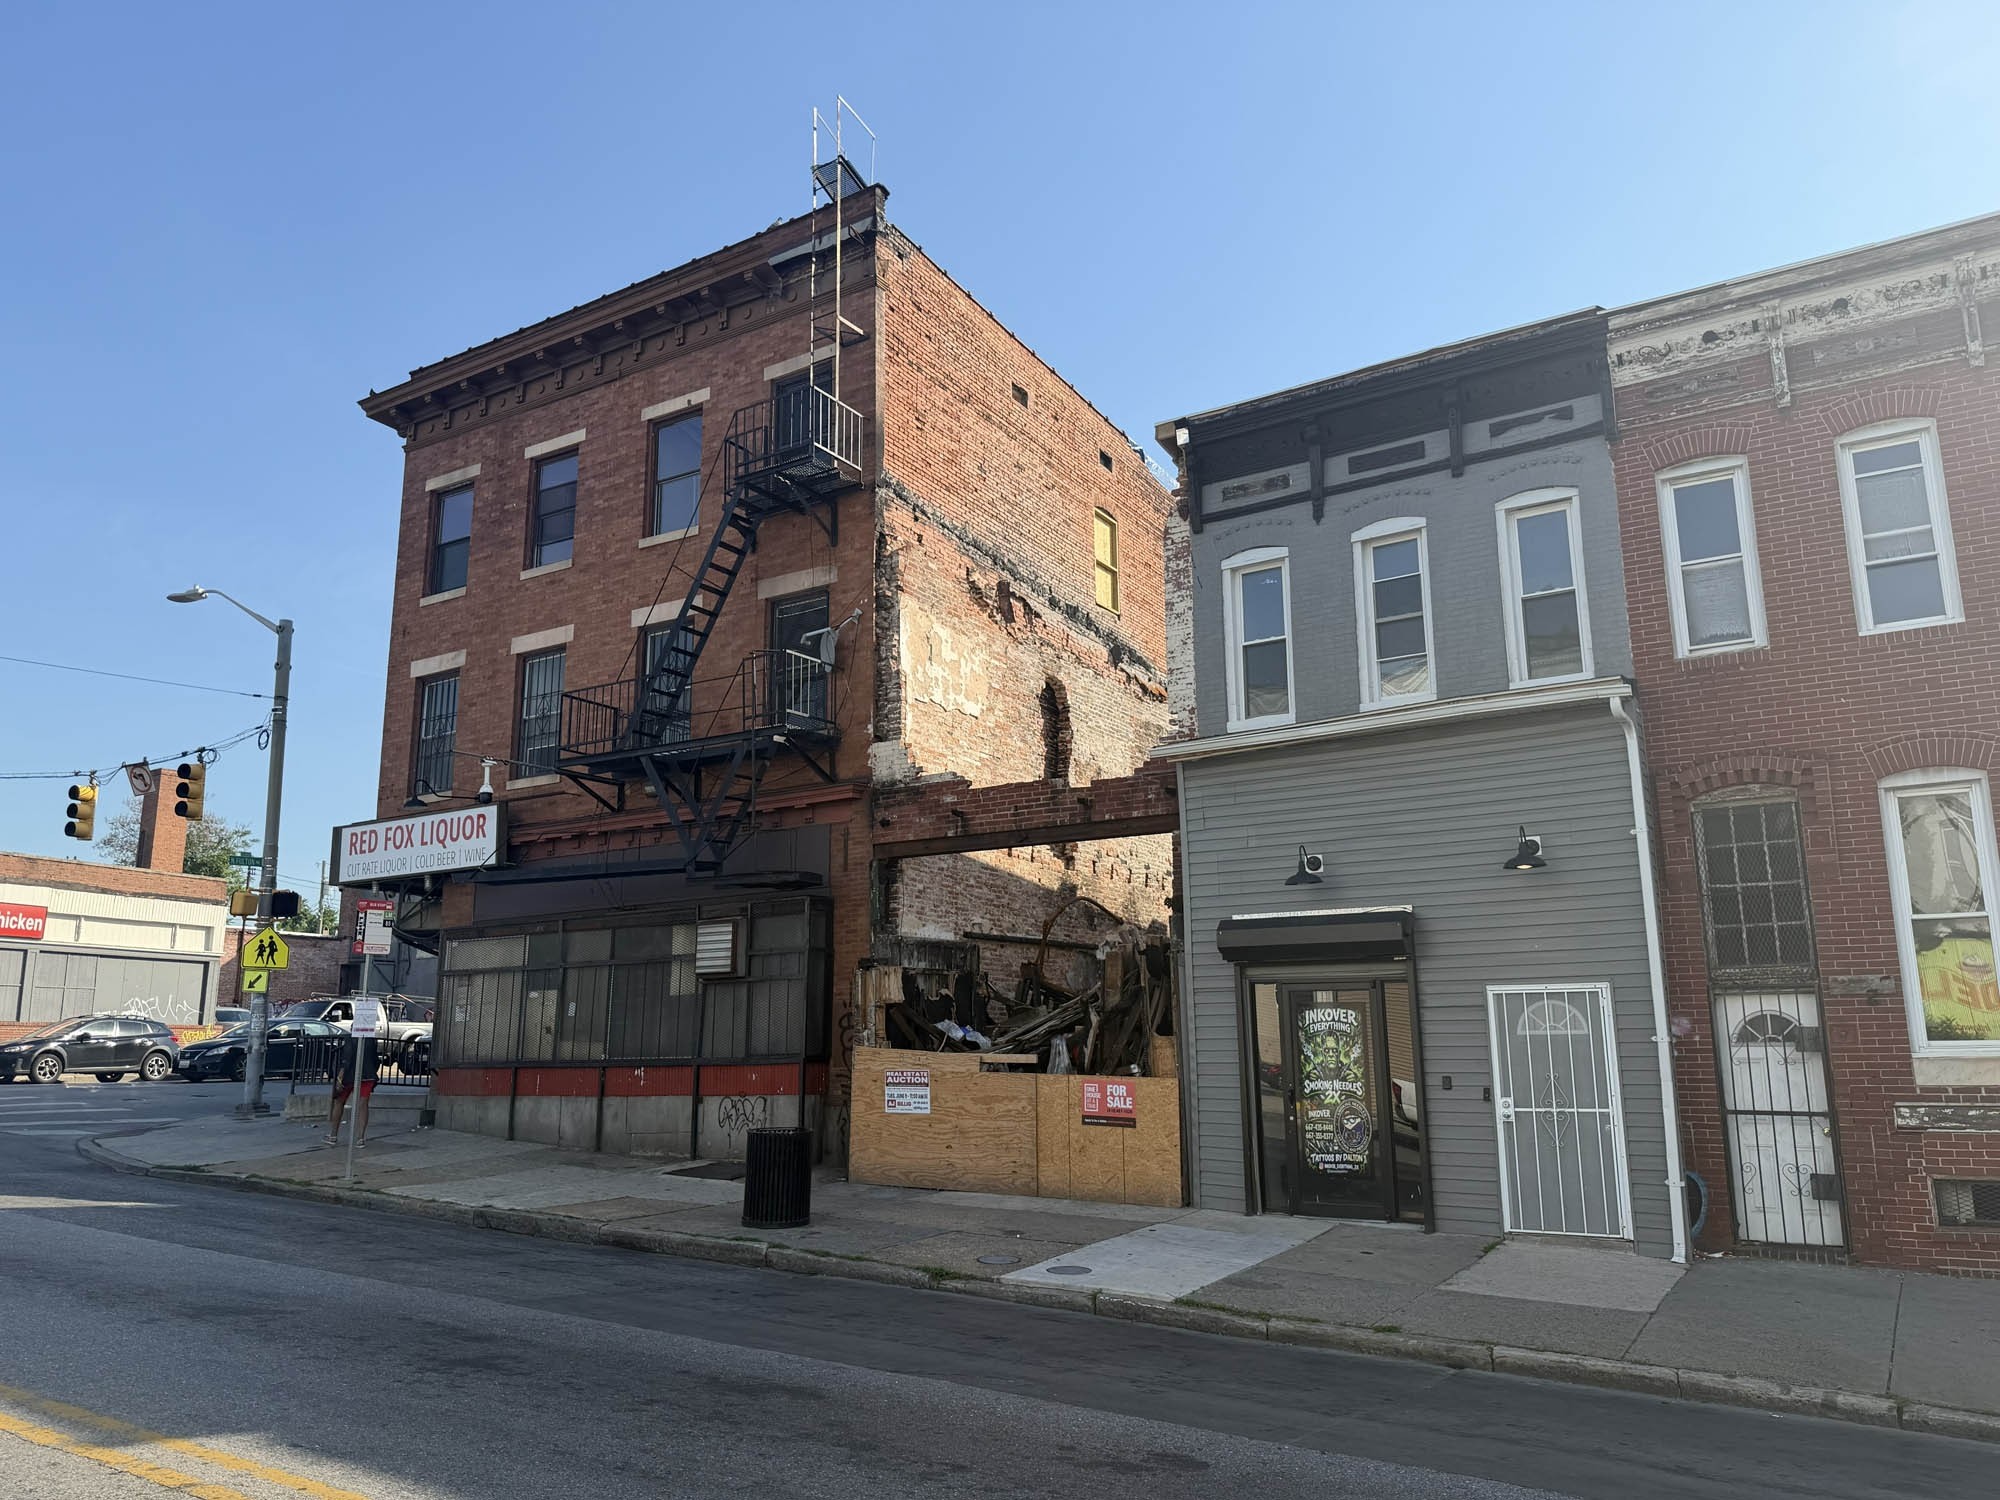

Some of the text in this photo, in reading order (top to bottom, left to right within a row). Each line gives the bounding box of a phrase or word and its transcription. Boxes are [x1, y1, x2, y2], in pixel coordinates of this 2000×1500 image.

[349, 813, 487, 856] RED FOX LIQUOR
[347, 847, 486, 878] CUT RATE LIQUOR COLD BEER WINE
[1303, 1008, 1358, 1027] INKOVER
[1310, 1021, 1351, 1033] EVERYTHING
[1106, 1084, 1127, 1096] FOR
[1304, 1079, 1363, 1096] SMOKING NEEDLES
[1106, 1096, 1133, 1109] SALE
[1324, 1090, 1341, 1105] 2X
[1310, 1153, 1335, 1163] TATTOOS
[1335, 1153, 1343, 1162] BY
